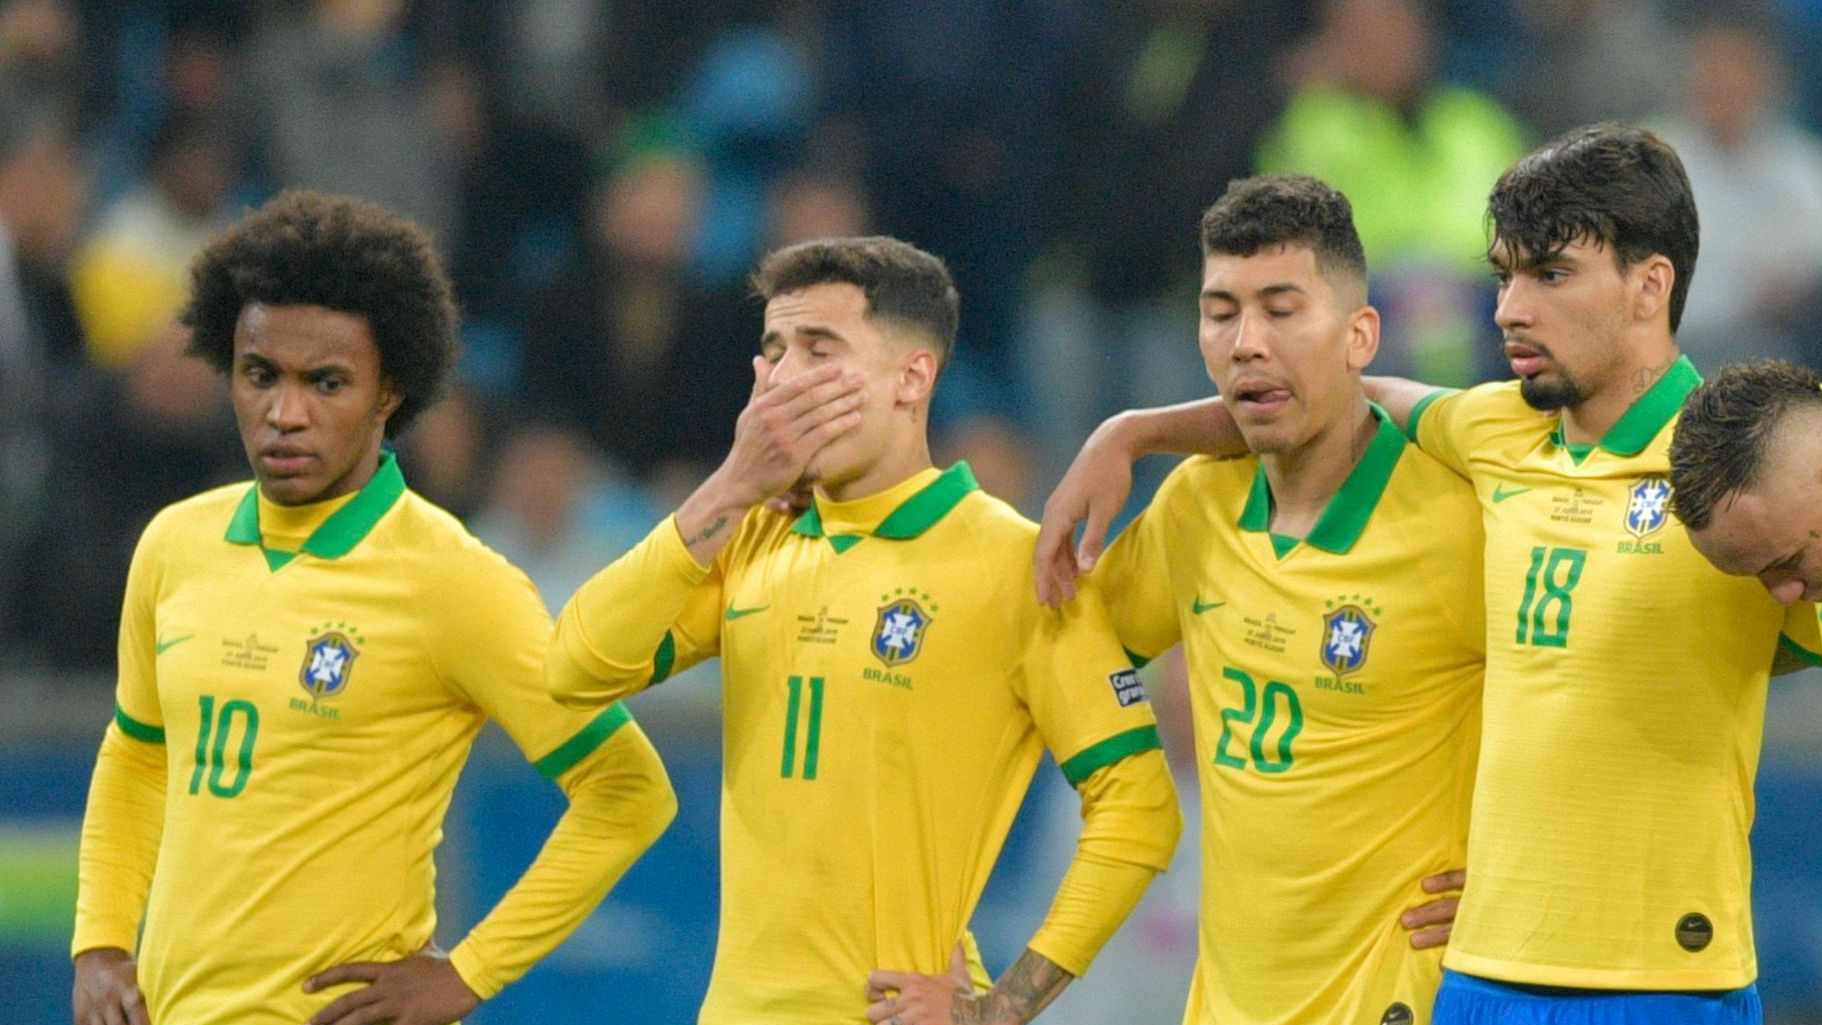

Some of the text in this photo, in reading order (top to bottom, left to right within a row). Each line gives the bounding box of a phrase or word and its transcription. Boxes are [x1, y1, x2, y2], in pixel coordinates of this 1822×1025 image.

[1616, 541, 1664, 554] BRASIL
[1515, 546, 1588, 649] 18
[288, 697, 341, 721] BRASIL
[863, 667, 914, 691] BRASIL
[1315, 676, 1366, 695] BRASIL
[189, 695, 260, 799] 10
[781, 675, 825, 781] 11
[1213, 666, 1304, 774] 20
